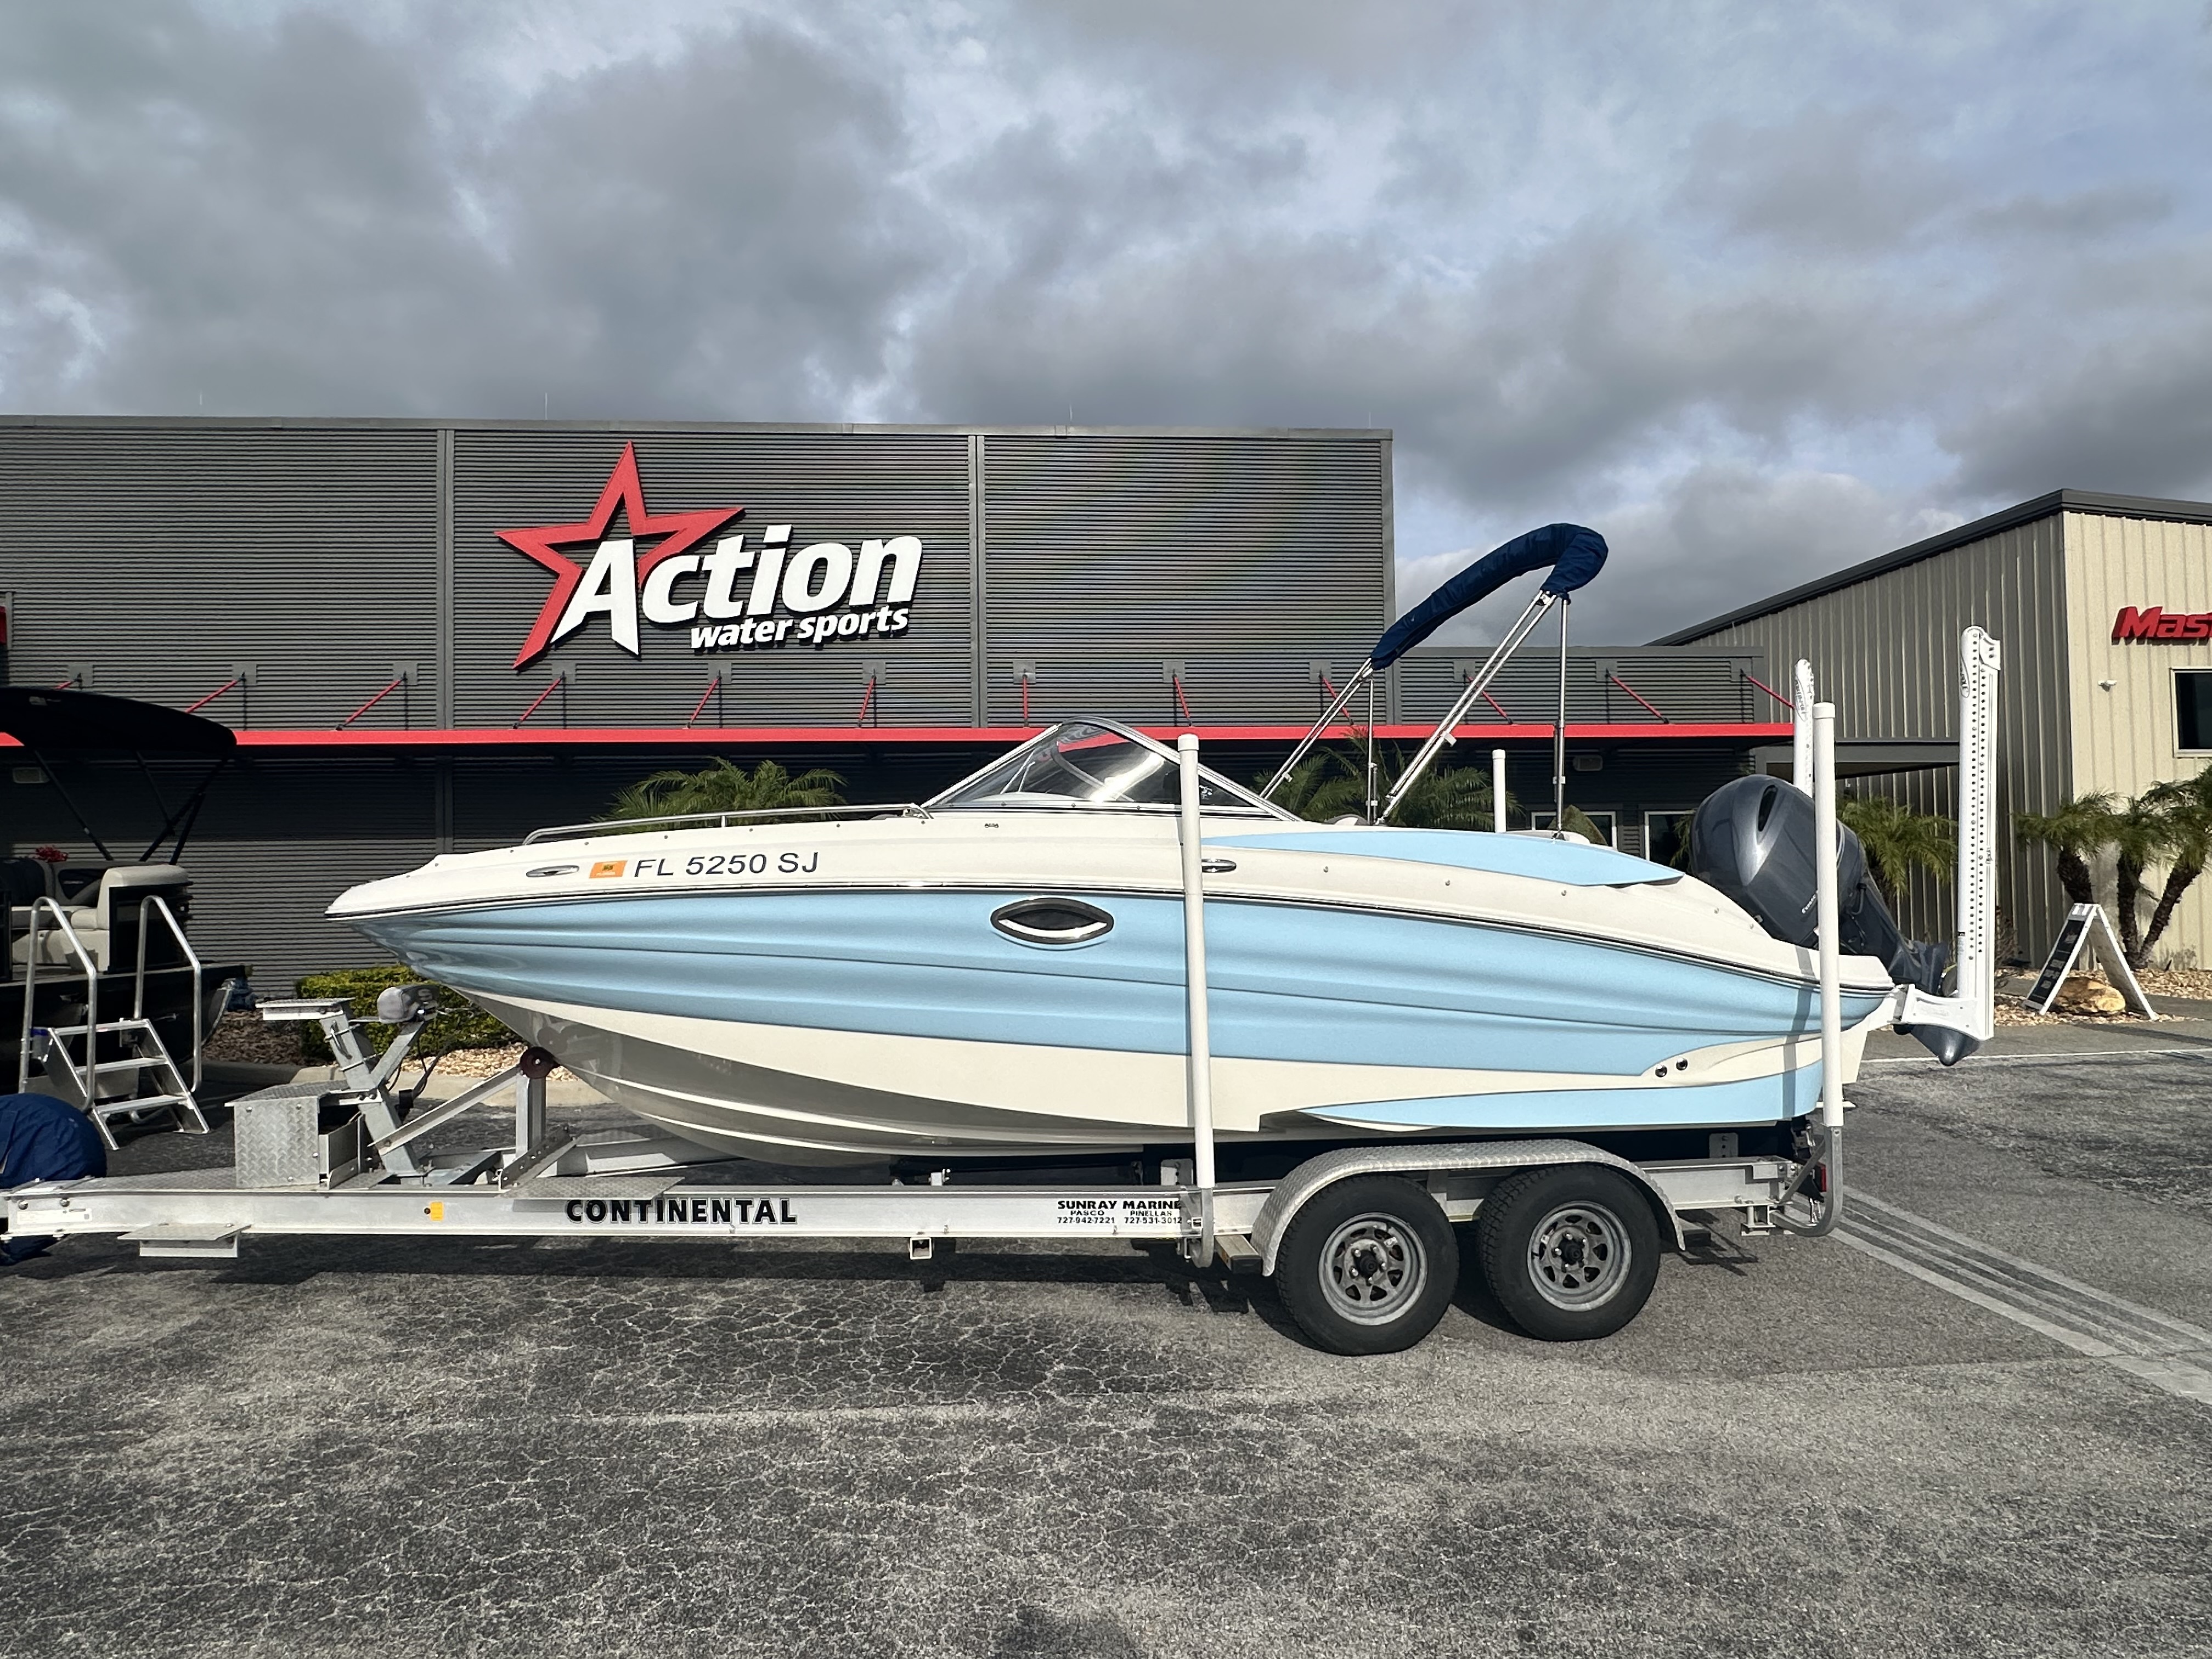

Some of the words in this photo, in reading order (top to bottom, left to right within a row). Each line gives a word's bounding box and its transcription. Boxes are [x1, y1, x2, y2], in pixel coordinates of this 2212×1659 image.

[551, 524, 922, 655] Action
[691, 618, 793, 648] water
[797, 605, 909, 643] sports
[2112, 606, 2212, 637] Mas
[634, 859, 674, 878] FL
[686, 854, 767, 875] 5250
[778, 851, 819, 873] SJ
[566, 1199, 797, 1223] CONTINENTAL
[1058, 1200, 1117, 1209] SUNRAY
